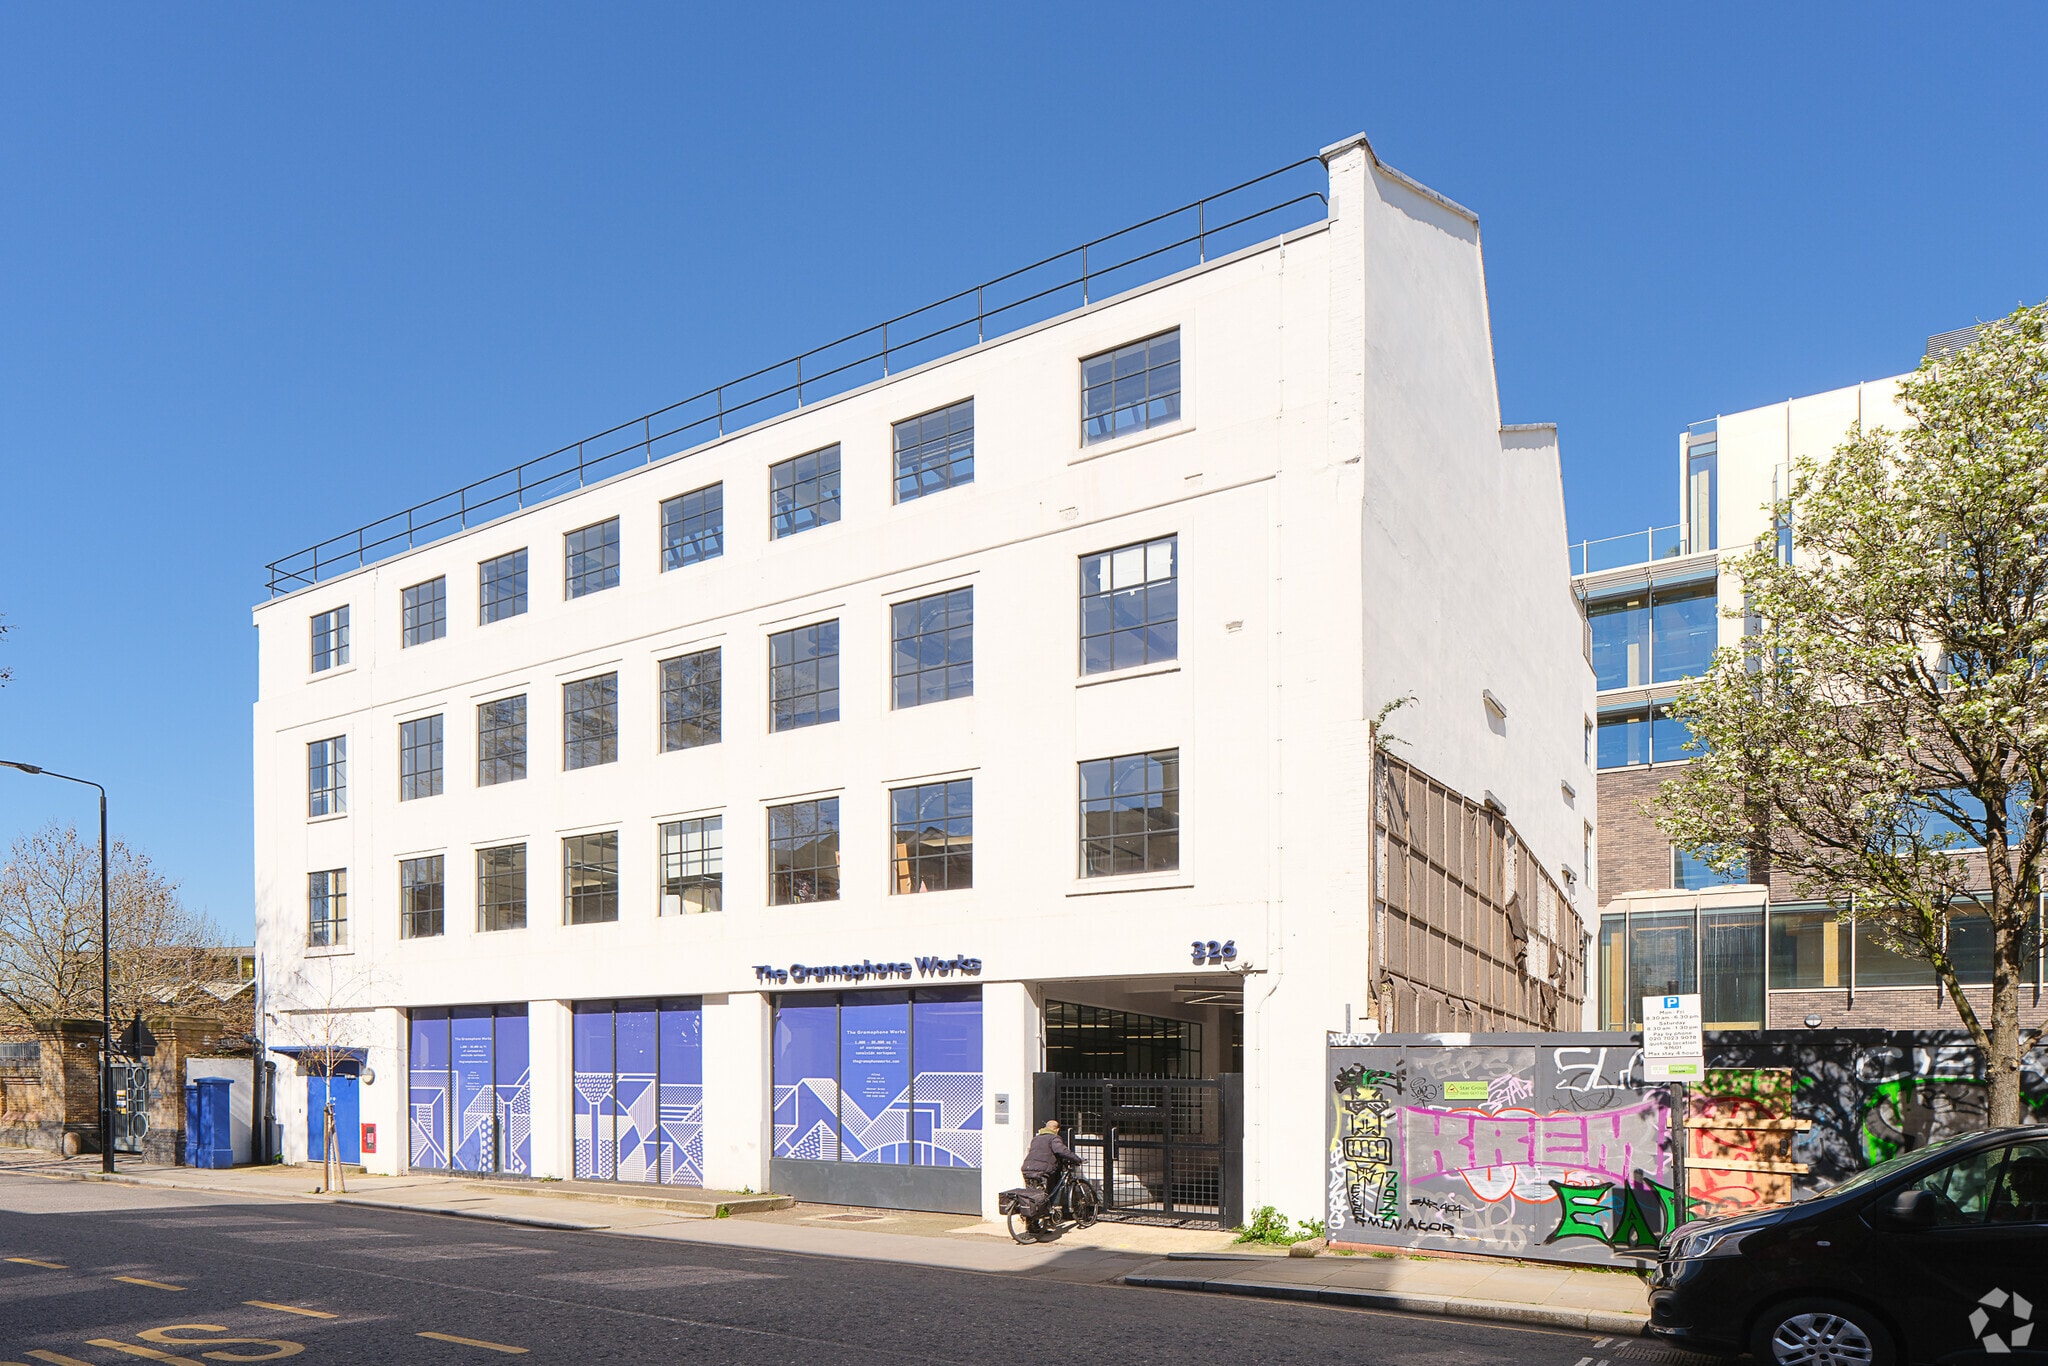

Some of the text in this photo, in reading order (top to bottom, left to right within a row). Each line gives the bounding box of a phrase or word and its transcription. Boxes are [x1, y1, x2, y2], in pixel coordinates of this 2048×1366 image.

[1191, 940, 1237, 962] 326
[752, 954, 982, 982] The Gramophone Works
[1667, 997, 1678, 1008] P
